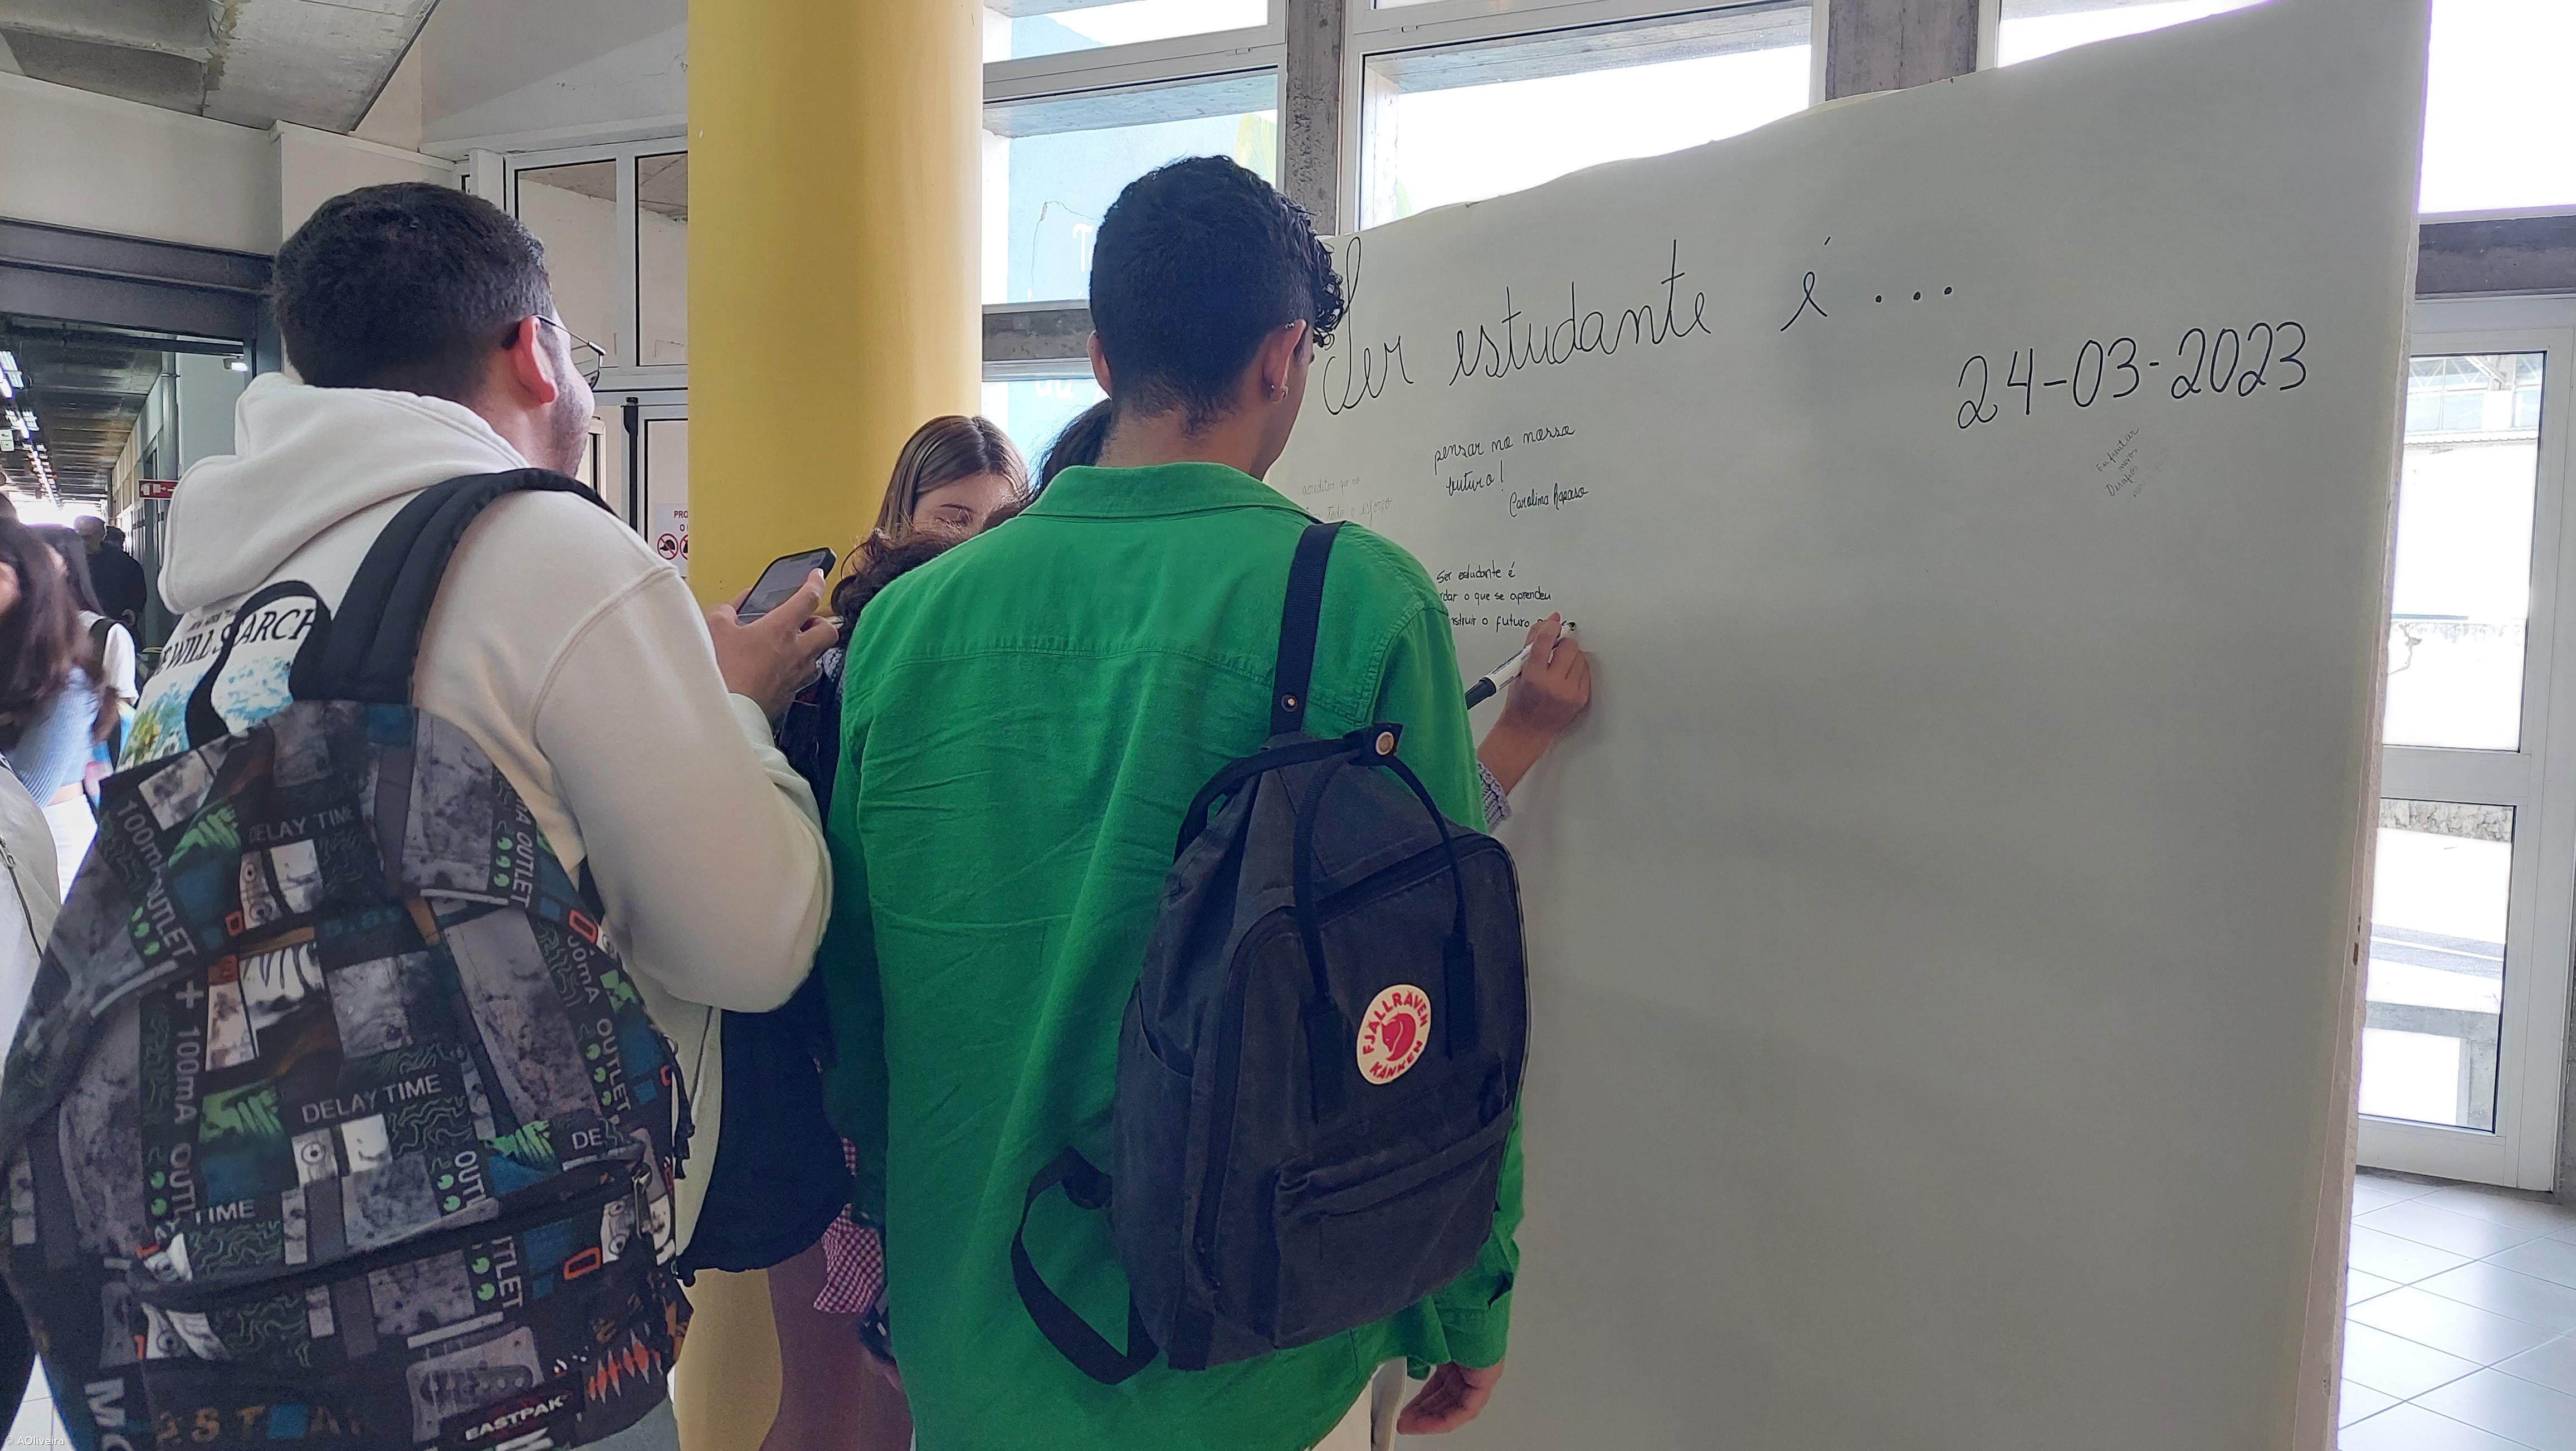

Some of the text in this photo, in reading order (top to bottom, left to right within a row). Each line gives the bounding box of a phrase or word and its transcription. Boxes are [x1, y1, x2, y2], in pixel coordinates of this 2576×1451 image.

[1323, 236, 1414, 415] Ser
[1448, 238, 1711, 386] estudante
[1780, 236, 1831, 332] é
[1957, 321, 2306, 429] 24-03-2023
[1433, 442, 1485, 476] pensar
[1509, 488, 1549, 518] Carolina
[1436, 559, 1516, 584] Ser estudante é
[1440, 588, 1458, 602] rdar
[1474, 592, 1490, 606] que
[1494, 592, 1505, 601] se
[1509, 586, 1552, 606] aprendeu
[212, 608, 317, 654] SARCH
[1451, 612, 1477, 627] nstruir
[1496, 613, 1530, 633] futuro
[510, 831, 535, 908] OUTLET
[174, 1024, 201, 1126] 100mA
[301, 1073, 442, 1124] DELAY TIME
[572, 1127, 602, 1150] DE
[169, 1142, 196, 1220] OUTL
[465, 1394, 568, 1441] EASTPAK
